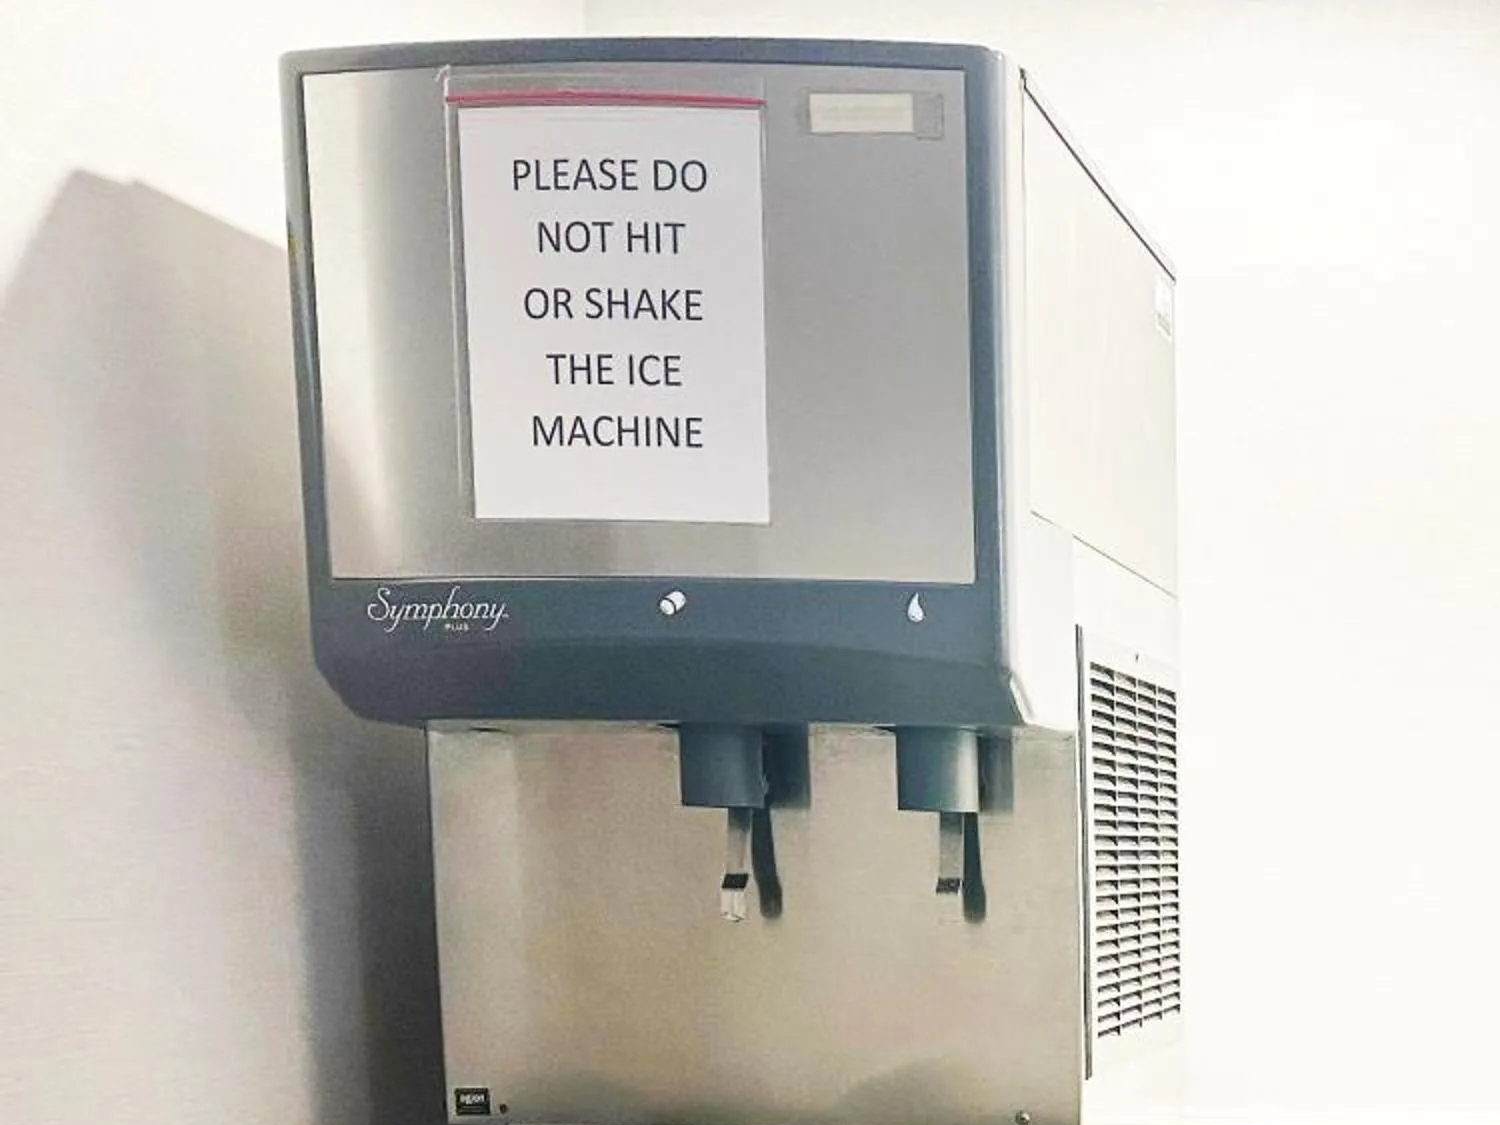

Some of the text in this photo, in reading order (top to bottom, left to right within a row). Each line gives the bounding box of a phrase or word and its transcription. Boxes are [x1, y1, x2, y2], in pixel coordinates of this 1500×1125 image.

[512, 159, 708, 193] PLEASE DO
[537, 222, 686, 255] NOT HIT
[523, 287, 703, 321] OR SHAKE
[546, 354, 682, 387] THE ICE
[532, 415, 703, 449] MACHINE
[367, 585, 505, 633] Symphony
